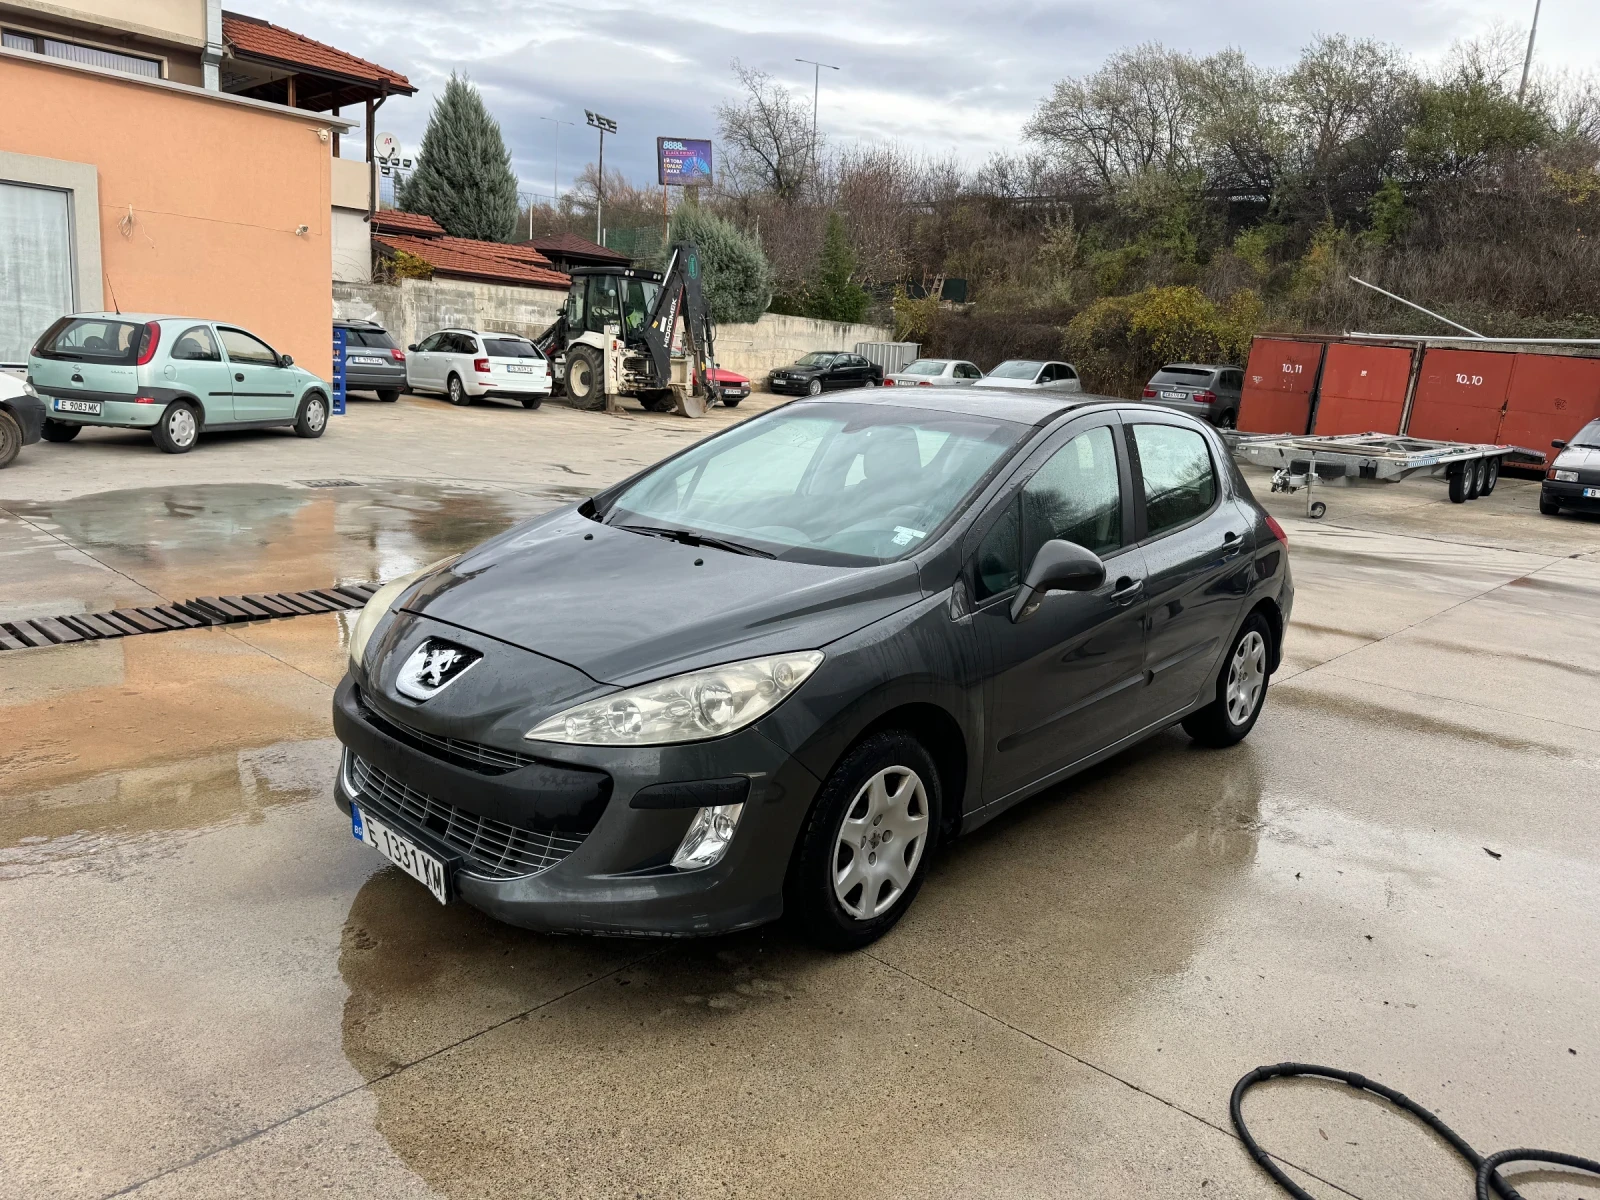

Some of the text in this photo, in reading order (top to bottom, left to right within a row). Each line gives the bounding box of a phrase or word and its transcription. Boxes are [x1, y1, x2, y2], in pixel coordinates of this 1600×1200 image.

[663, 141, 683, 150] 8888
[663, 298, 677, 348] HIDROMEK
[1282, 363, 1303, 374] 10.11
[1455, 373, 1483, 386] 10.10
[61, 401, 98, 412] E 9083 MK
[354, 825, 362, 836] BG
[365, 816, 379, 848] E
[383, 830, 420, 877] 1331
